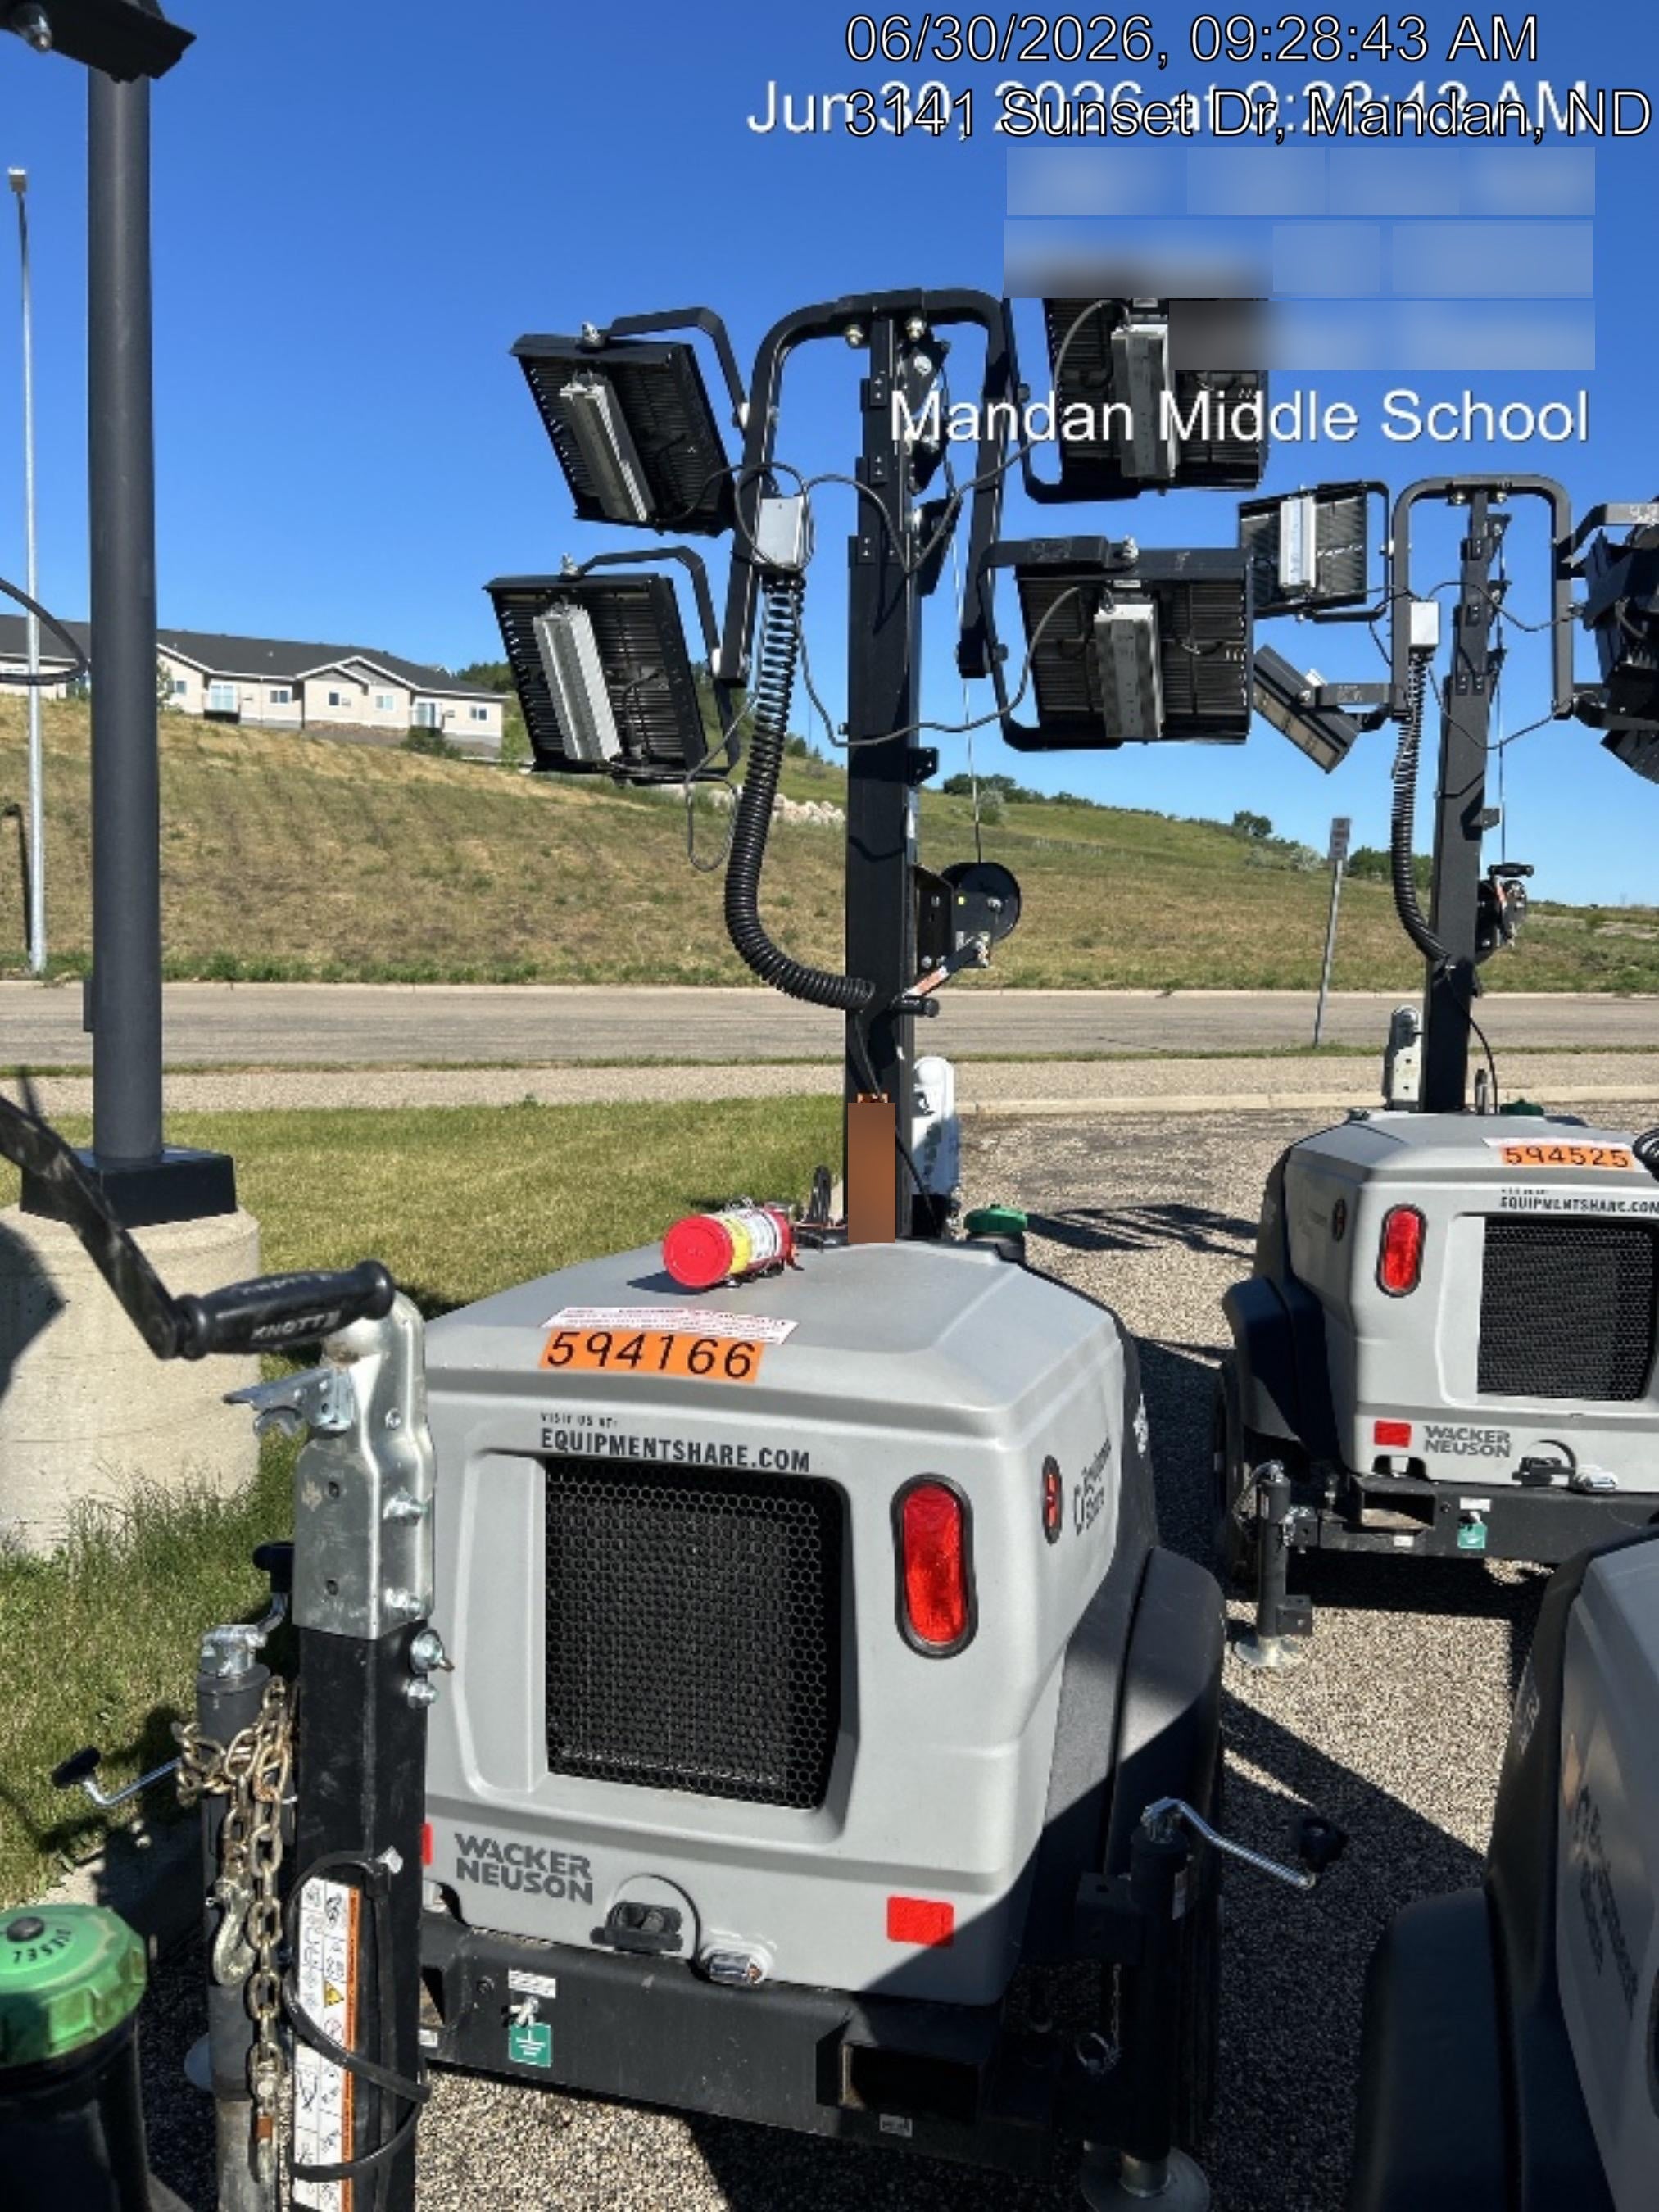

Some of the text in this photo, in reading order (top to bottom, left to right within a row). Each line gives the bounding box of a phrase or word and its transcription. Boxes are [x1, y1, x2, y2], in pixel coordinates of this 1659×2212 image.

[1504, 1145, 1630, 1169] 594525
[249, 1314, 326, 1340] KNOTT
[546, 1330, 756, 1380] 594166
[542, 1428, 810, 1472] EQUIPMENTSHARE.COM
[1424, 1425, 1511, 1444] WACKER
[1426, 1439, 1511, 1458] NEUSON
[453, 1832, 592, 1881] WACKER
[456, 1857, 593, 1905] NEUSON
